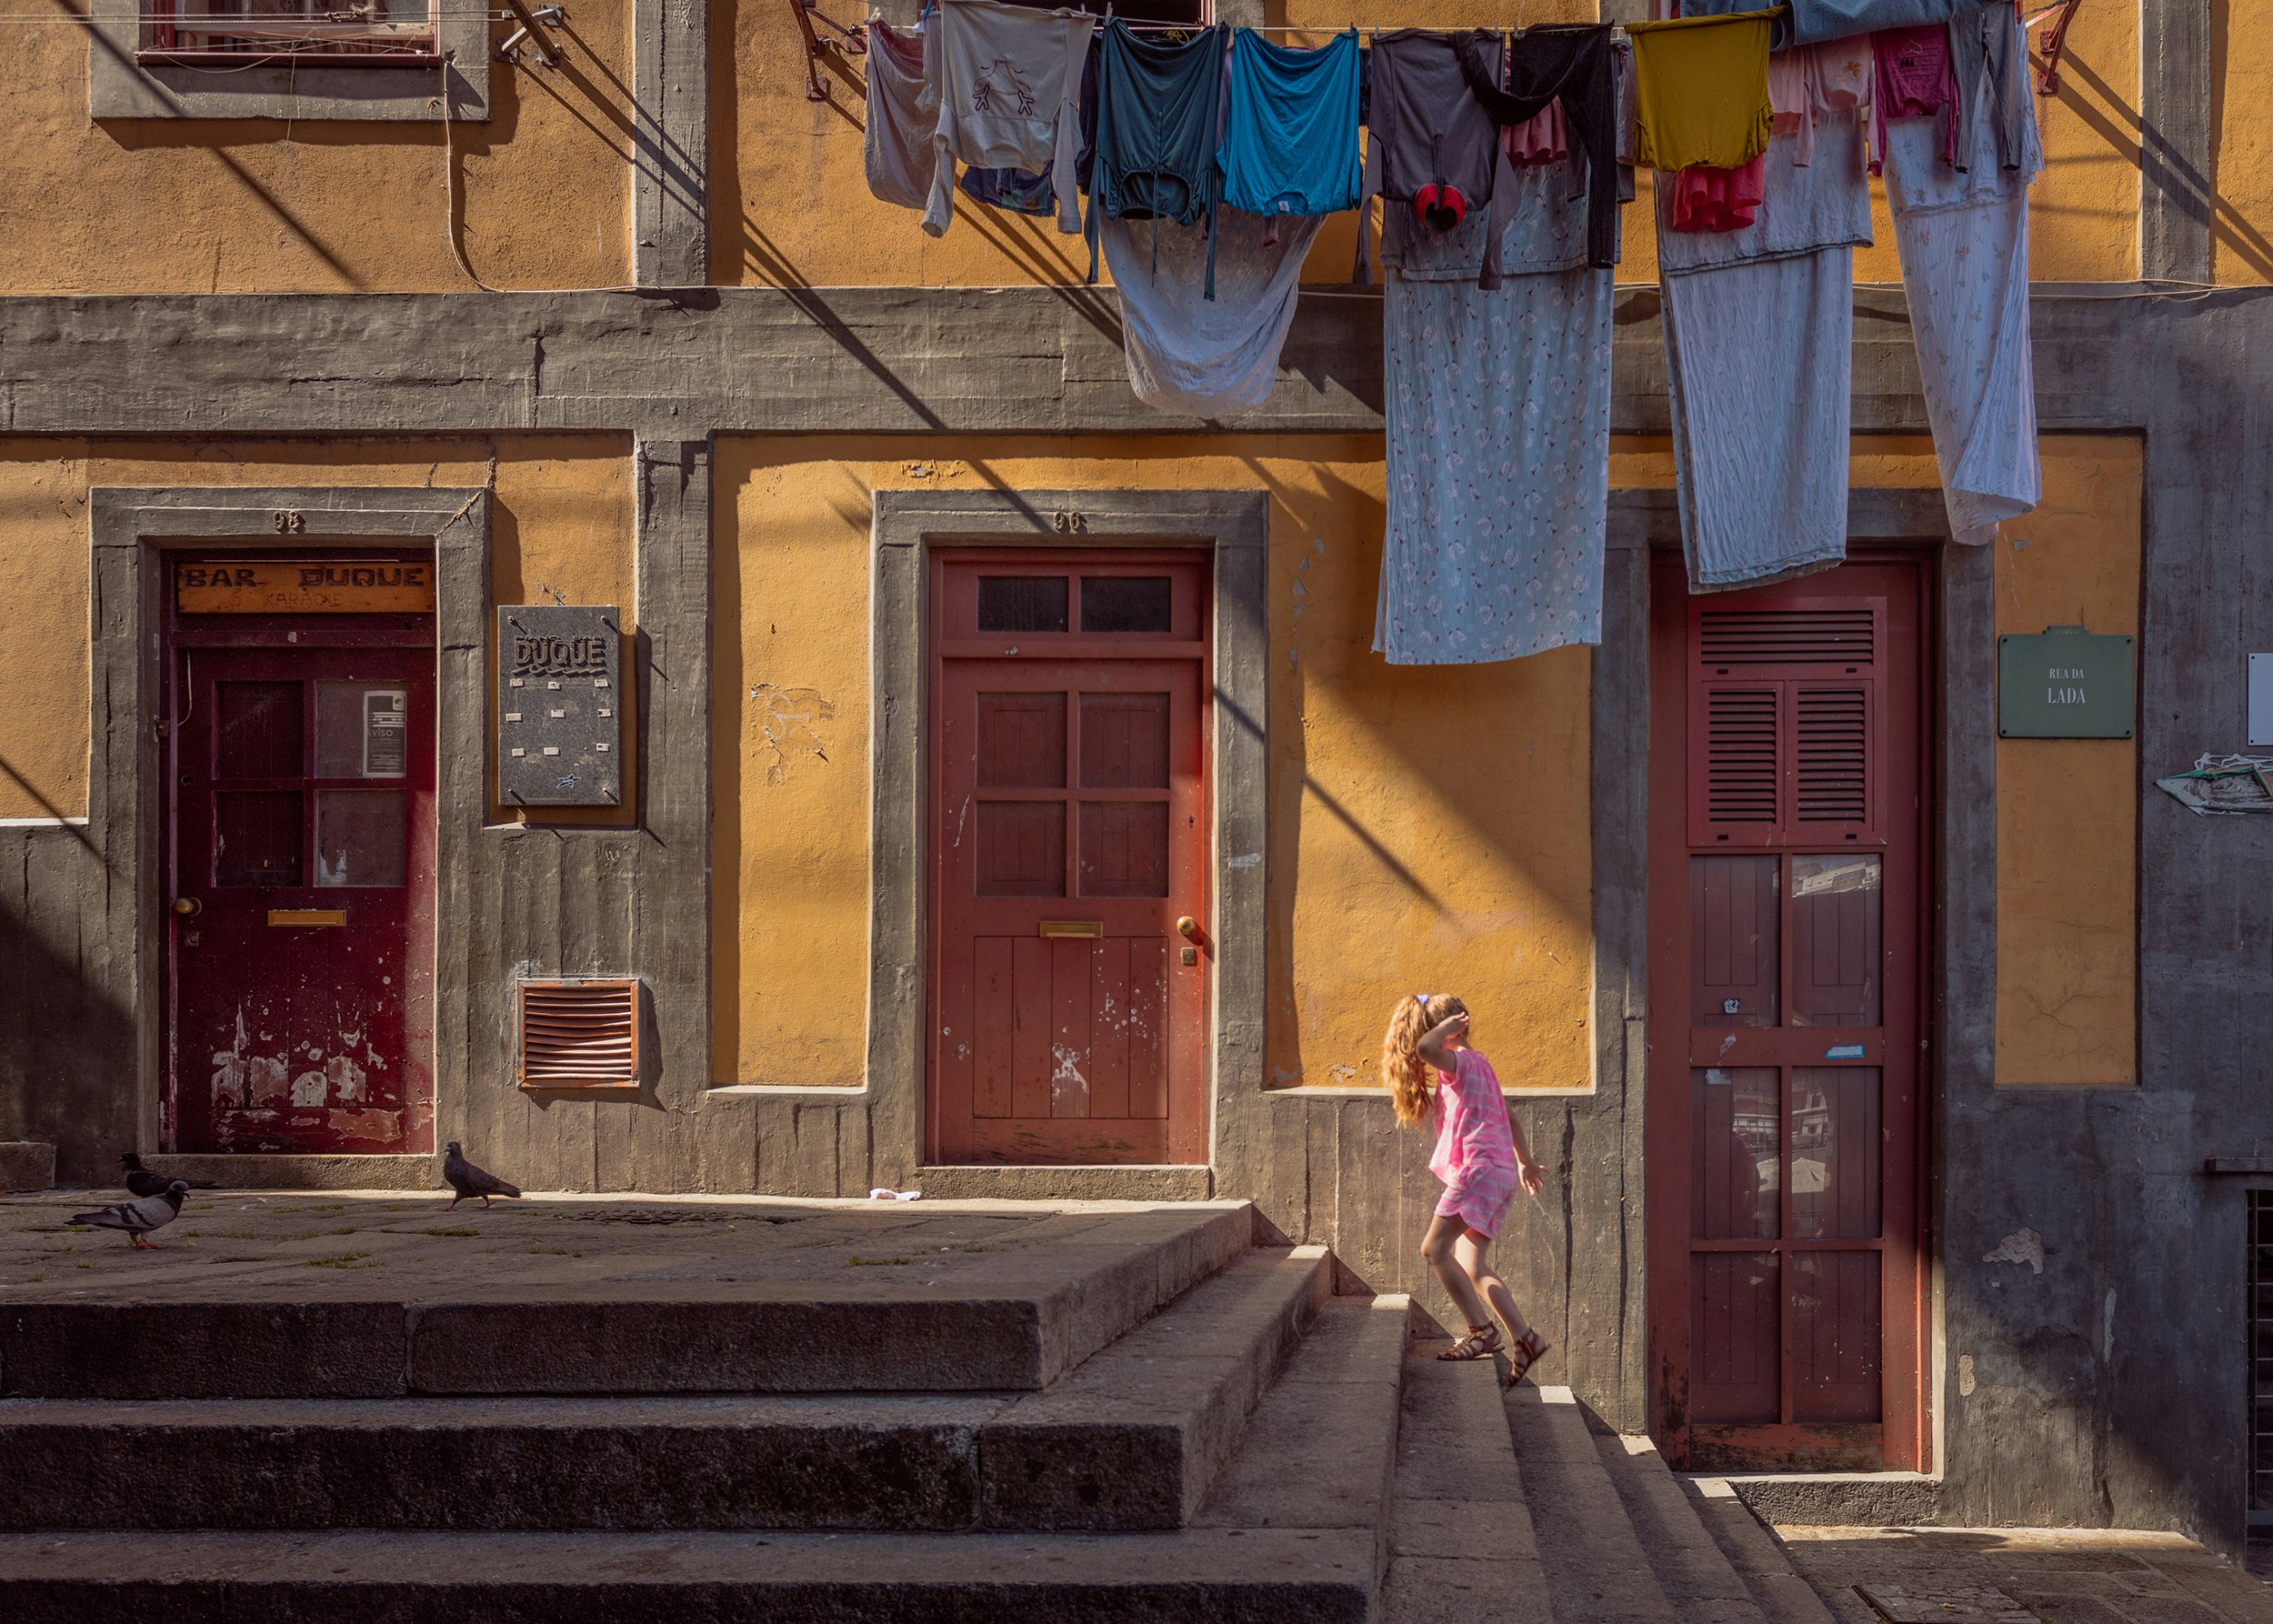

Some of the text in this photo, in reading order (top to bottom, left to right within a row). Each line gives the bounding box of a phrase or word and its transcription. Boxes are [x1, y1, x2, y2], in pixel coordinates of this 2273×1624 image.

[273, 510, 298, 529] 98
[1054, 510, 1081, 529] 96
[185, 567, 425, 587] BAR DUQUE
[265, 593, 343, 607] KARAOKE
[514, 637, 606, 666] DUQUE
[2049, 668, 2085, 679] RUA DA
[2048, 687, 2086, 704] LADA
